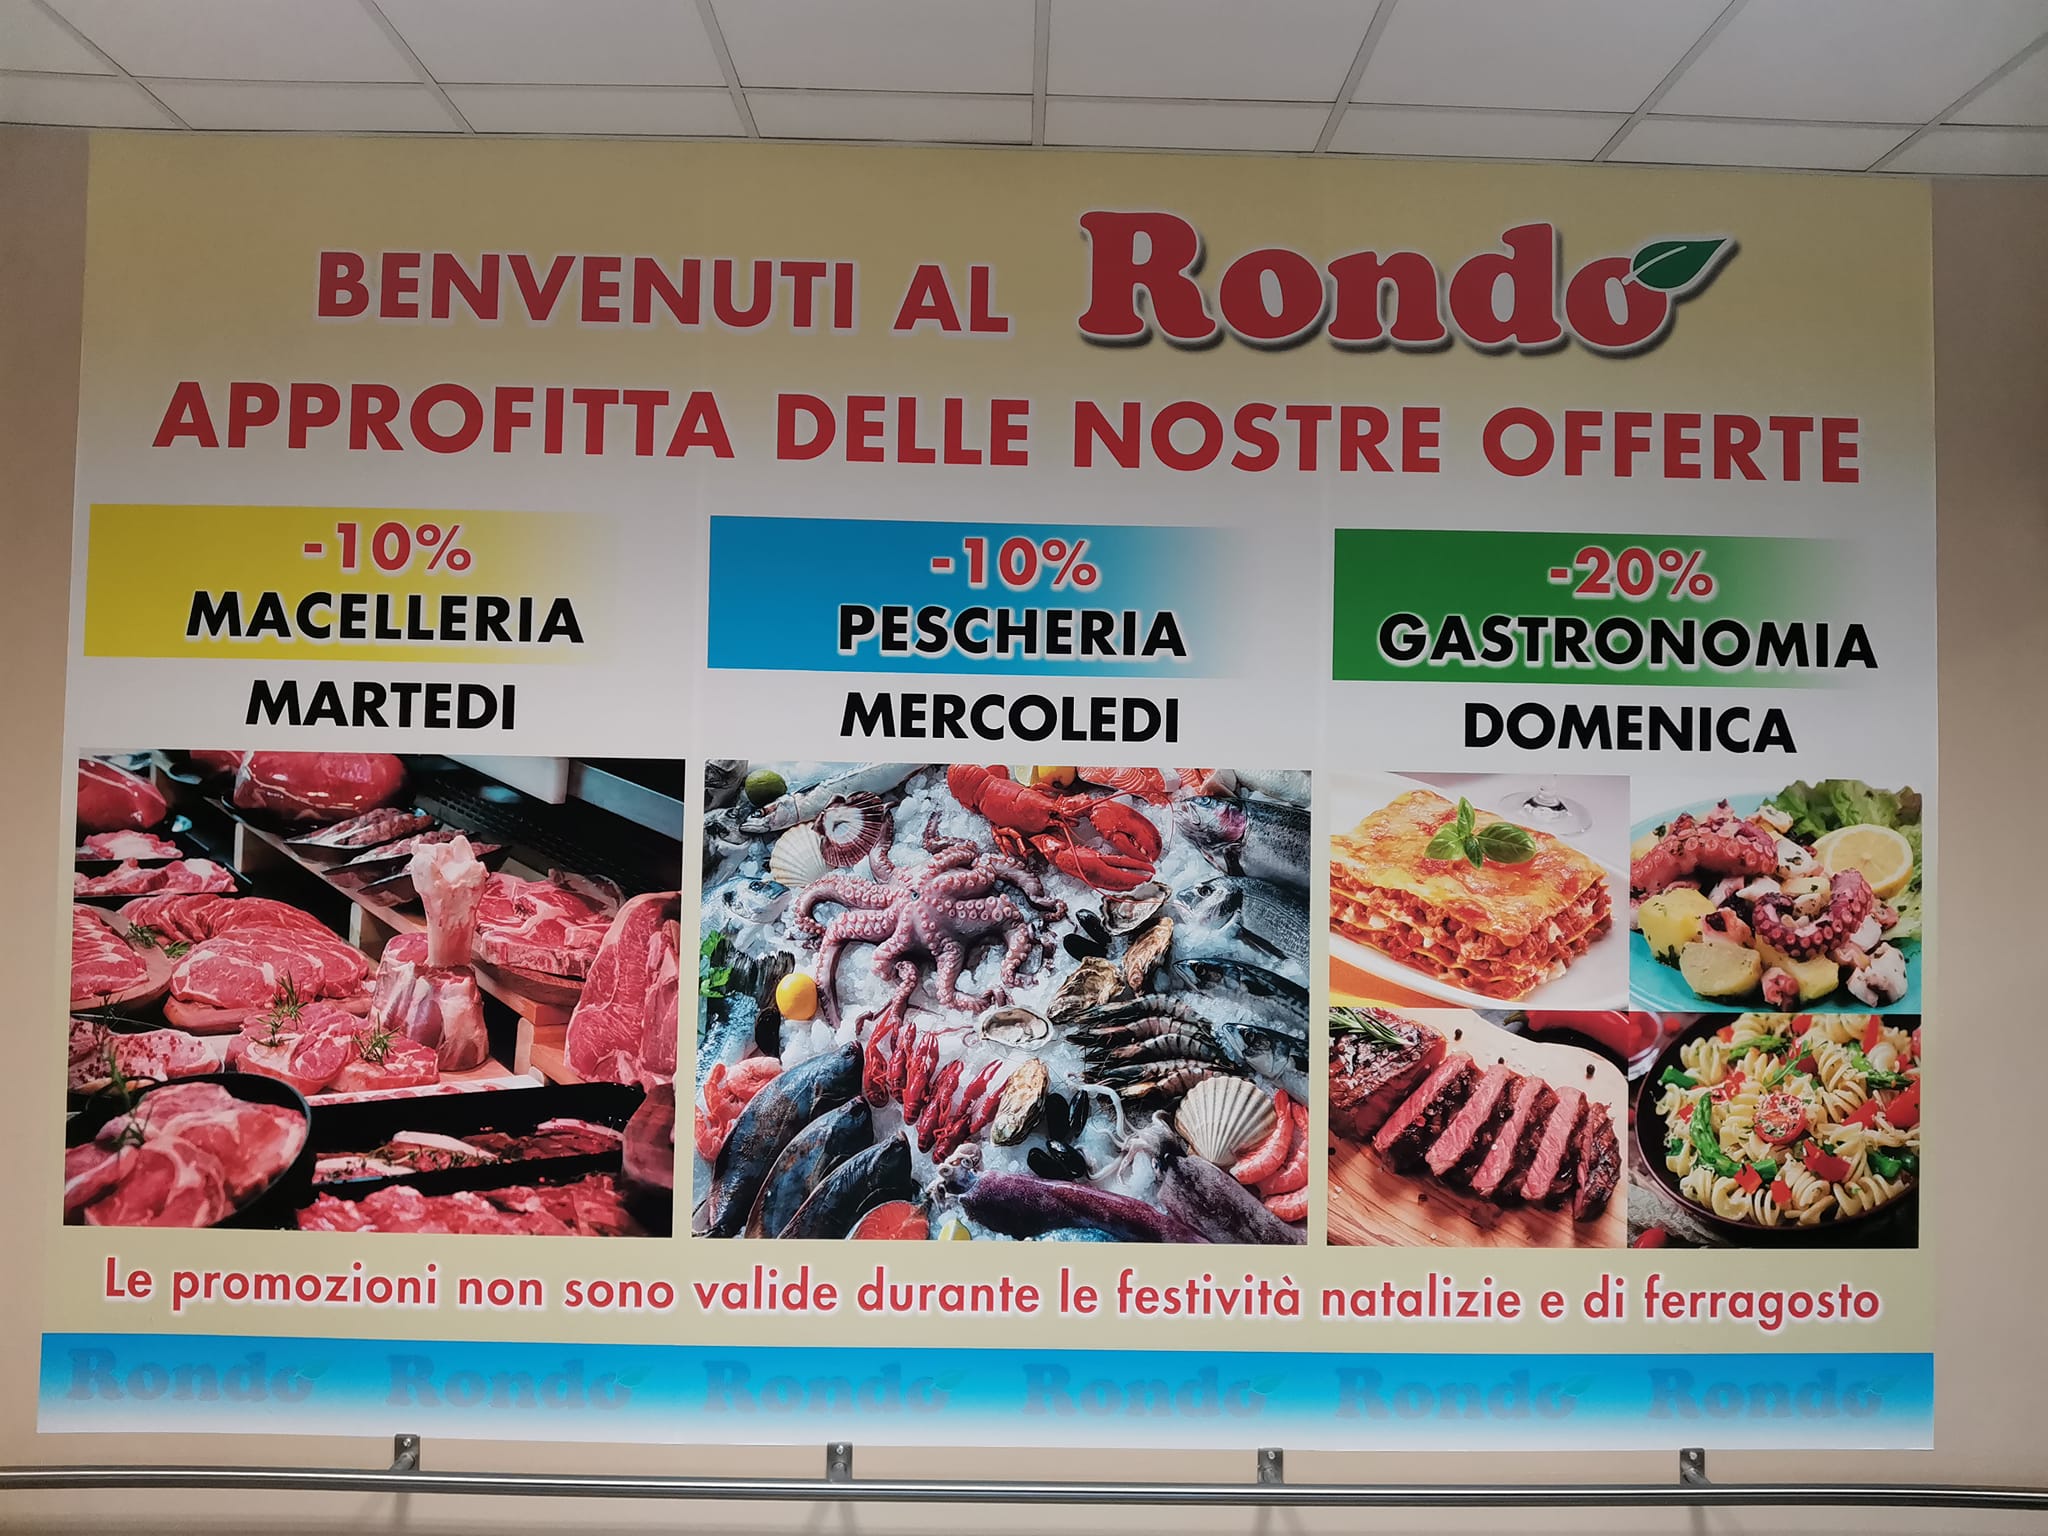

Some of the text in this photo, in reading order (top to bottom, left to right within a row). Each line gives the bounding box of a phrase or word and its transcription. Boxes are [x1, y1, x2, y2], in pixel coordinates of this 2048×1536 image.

[318, 252, 853, 329] BENVENUTI
[895, 265, 1009, 333] AL
[154, 381, 1859, 483] APPROFITTA DELLE NOSTRE OFFERTE
[303, 522, 472, 572] -10%
[931, 538, 1097, 586] -10%
[1549, 547, 1713, 596] -20%
[186, 590, 584, 643] MACELLERIA
[839, 605, 1187, 657] PESCHERIA
[1379, 613, 1878, 669] GASTRONOMIA
[245, 679, 515, 730] MARTEDI
[840, 692, 1179, 743] MERCOLEDI
[1464, 702, 1797, 754] DOMENICA
[105, 1256, 1880, 1331] Le promozioni non sono valide durante le festività natalizie e di ferragosto
